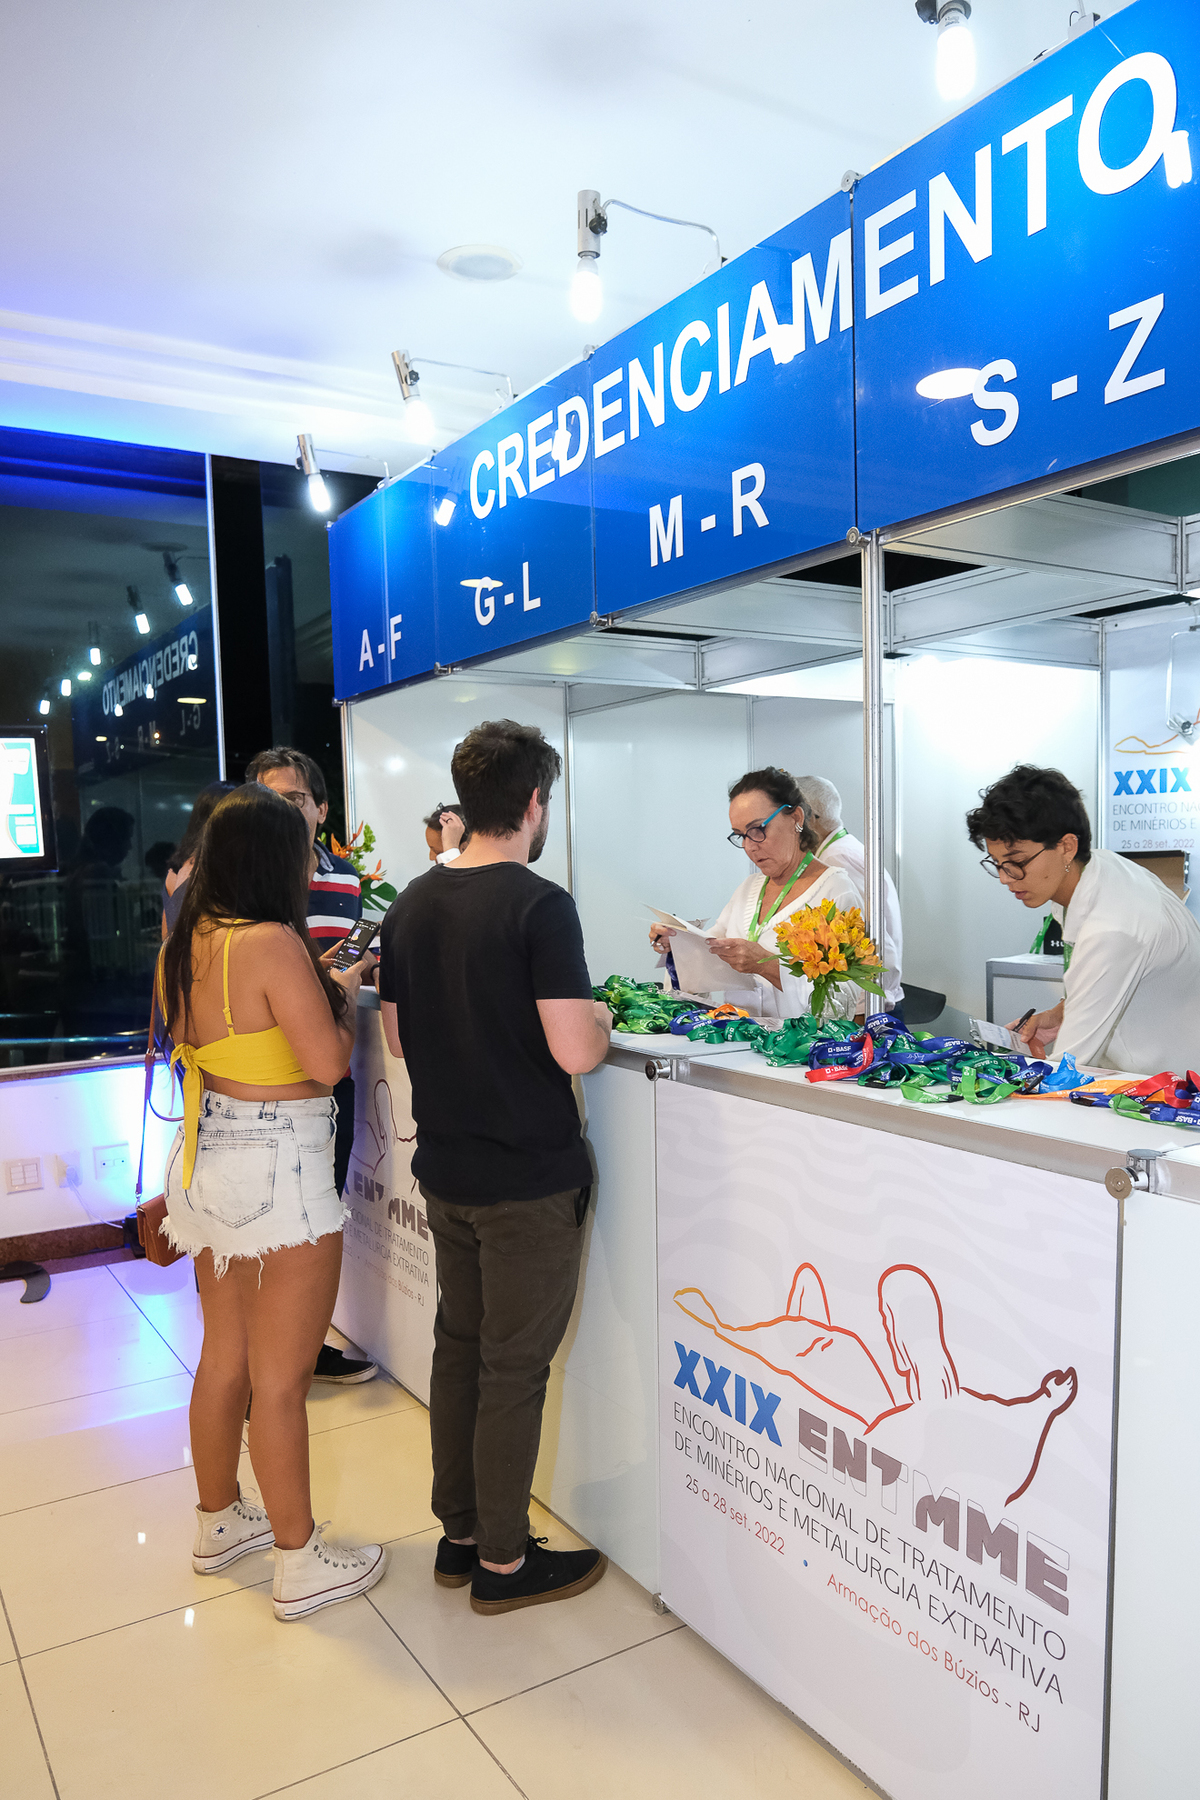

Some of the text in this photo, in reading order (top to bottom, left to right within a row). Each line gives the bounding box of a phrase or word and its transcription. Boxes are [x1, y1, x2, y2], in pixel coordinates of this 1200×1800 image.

[470, 51, 1178, 520] CREDENCIAMENTO
[970, 359, 1019, 446] S
[1104, 293, 1165, 405] Z
[649, 494, 684, 568] M
[731, 462, 770, 537] R
[1113, 767, 1192, 796] XXIX
[1113, 802, 1178, 815] ENCONTRO
[1113, 820, 1127, 832] DE
[1130, 816, 1187, 831] MINÉRIOS
[1121, 839, 1132, 849] 25
[1142, 839, 1153, 849] 28
[1173, 838, 1195, 848] 2022
[384, 1226, 429, 1266] TRATAMENTO
[393, 1252, 430, 1287] EXTRATIVA
[673, 1340, 1070, 1616] XXIX ENTMME
[685, 1473, 785, 1555] 25 a 28 set. 2022
[673, 1401, 1066, 1661] ENCONTRO NACIONAL DE TRATAMENTO
[674, 1430, 1064, 1704] DE MINÉRIOS E METALURGIA EXTRATIVA
[827, 1573, 902, 1636] Armação
[907, 1630, 938, 1662] dos
[943, 1650, 999, 1704] Búzios
[1018, 1701, 1040, 1733] RJ
